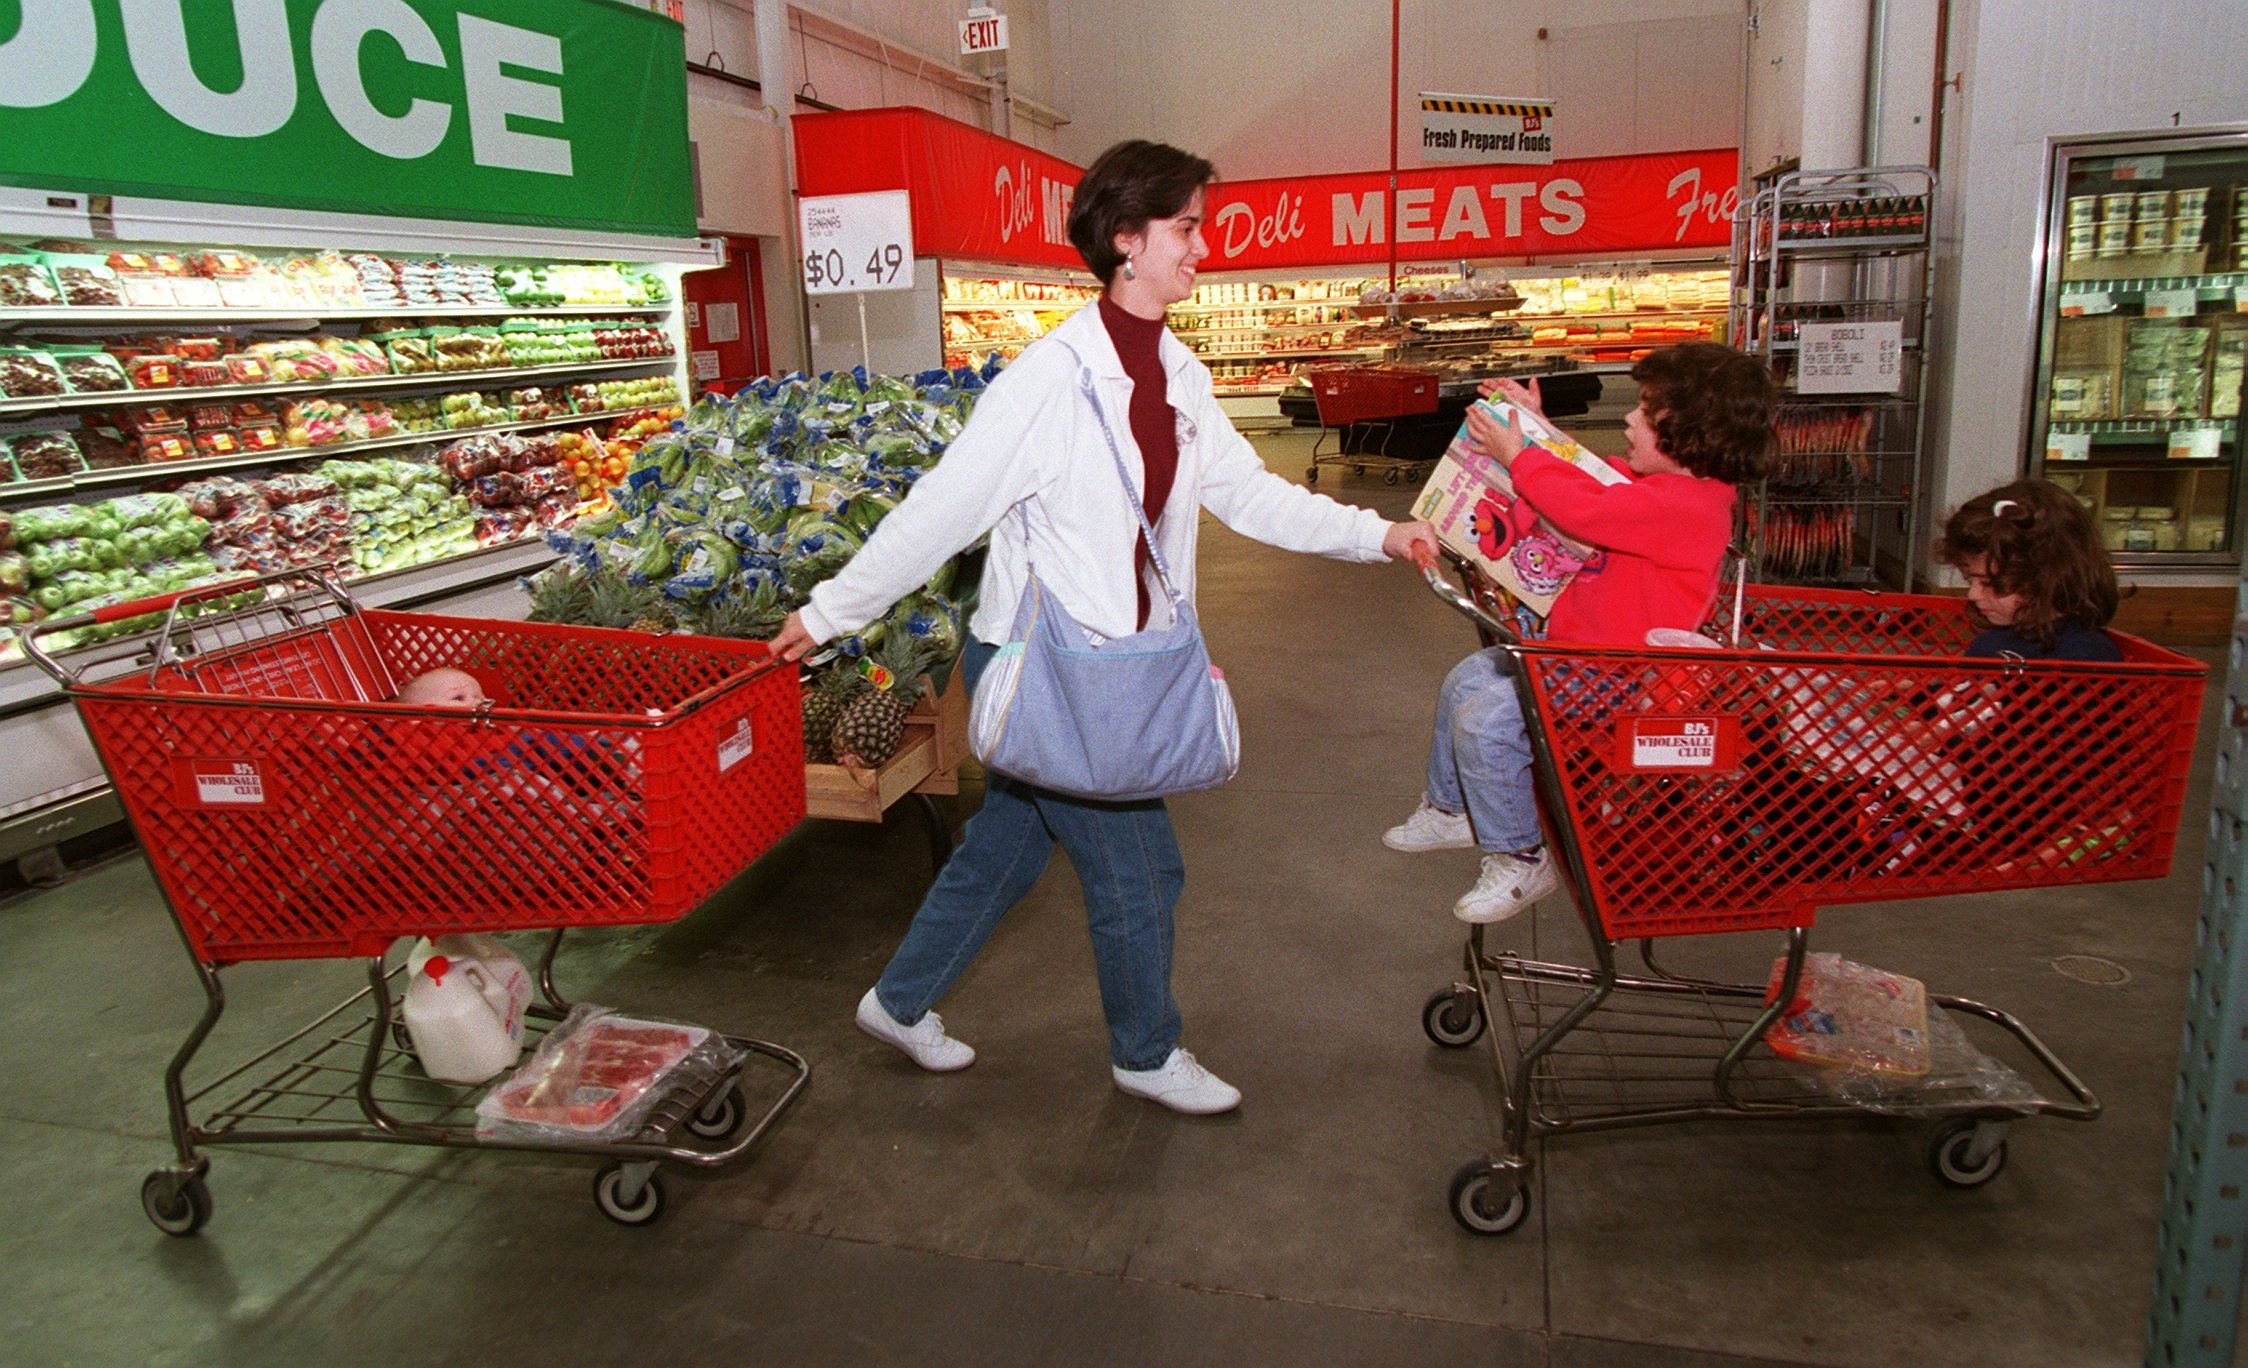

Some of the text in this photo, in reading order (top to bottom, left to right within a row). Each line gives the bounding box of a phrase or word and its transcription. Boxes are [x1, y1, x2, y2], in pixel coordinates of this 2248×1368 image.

[968, 19, 999, 49] EXIT
[1424, 128, 1551, 153] Fresh Prepared Foods
[995, 159, 1034, 244] Deli
[1215, 191, 1305, 259] Deli
[1331, 178, 1586, 247] MEATS
[1403, 265, 1449, 275] Cheeses
[1831, 328, 1865, 341] BOBOLI
[1684, 723, 1709, 735] BJ's
[1637, 737, 1712, 748] WHOLESALE
[1678, 747, 1711, 757] CLUB
[198, 776, 260, 786] WHOLESALE
[234, 786, 261, 795] CLUB
